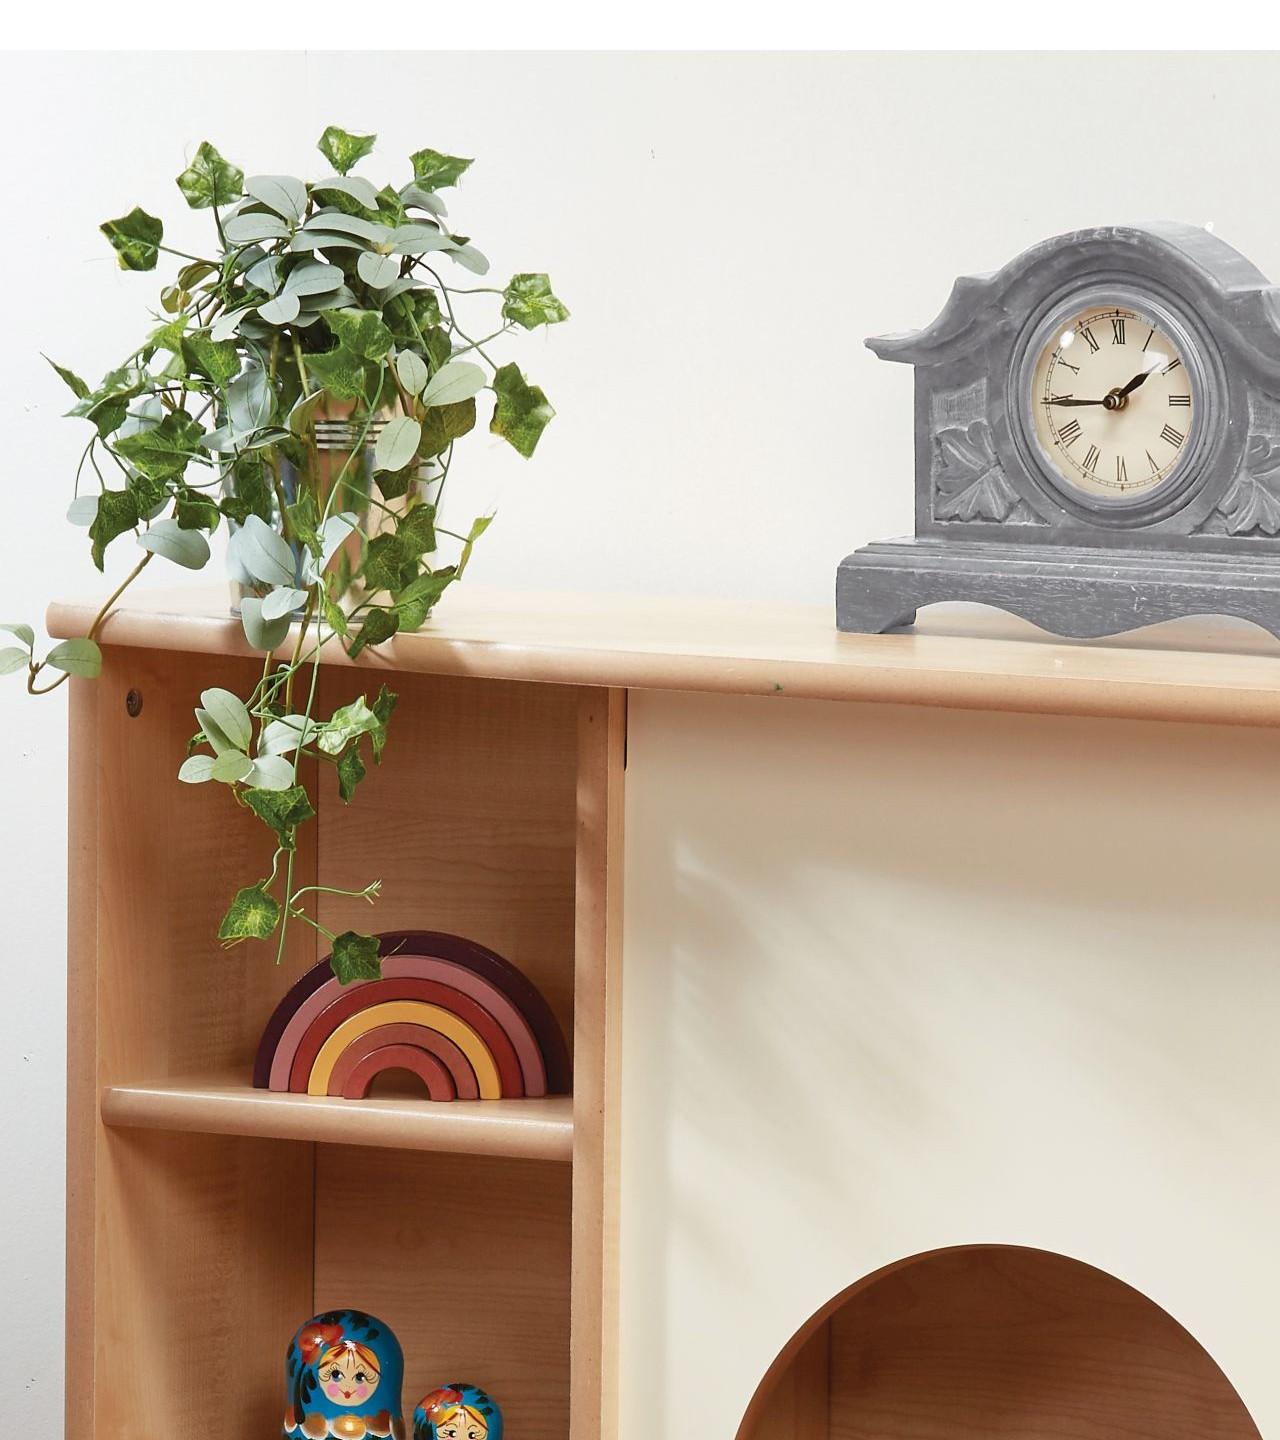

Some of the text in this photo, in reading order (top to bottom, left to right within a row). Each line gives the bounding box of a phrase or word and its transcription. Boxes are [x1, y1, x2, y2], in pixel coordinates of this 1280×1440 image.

[1081, 328, 1100, 354] XI
[1111, 319, 1126, 344] XII
[1057, 356, 1081, 376] X
[1169, 395, 1191, 407] III
[1145, 449, 1160, 474] V
